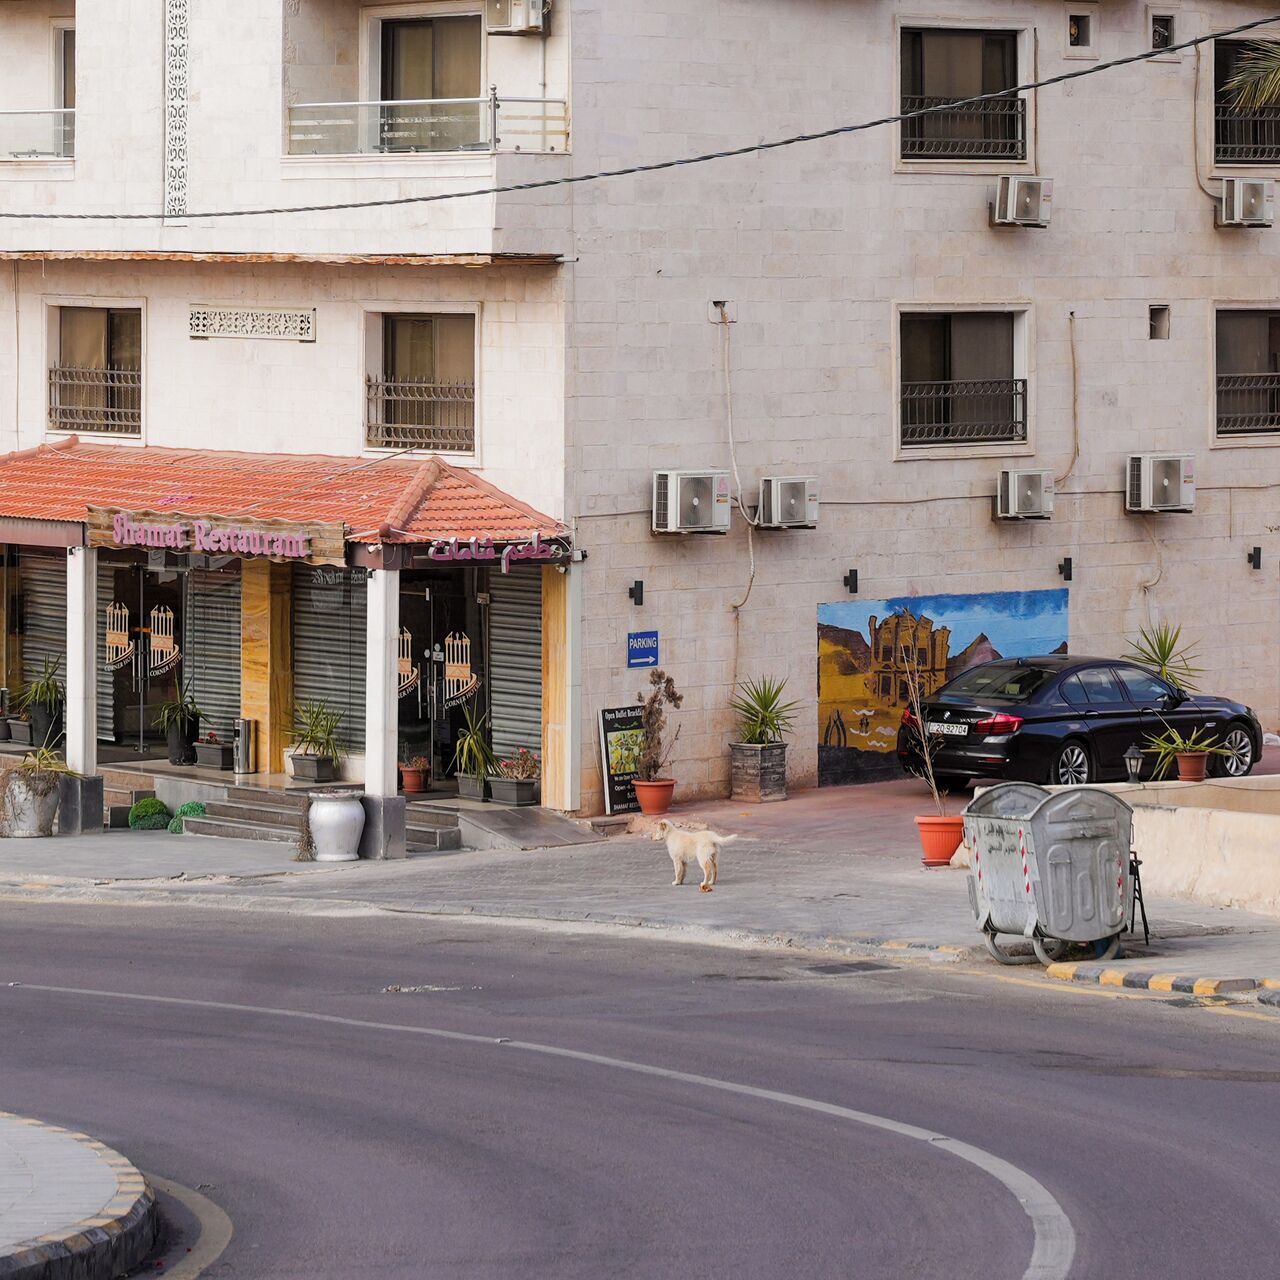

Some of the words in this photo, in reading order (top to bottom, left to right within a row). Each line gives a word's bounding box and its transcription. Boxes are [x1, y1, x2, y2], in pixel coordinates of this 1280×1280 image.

[112, 512, 191, 550] Shamat
[192, 519, 308, 559] Restaurant
[427, 535, 496, 561] شامات
[501, 529, 563, 577] مطعم
[629, 636, 658, 649] PARKING
[149, 666, 169, 677] CORNER
